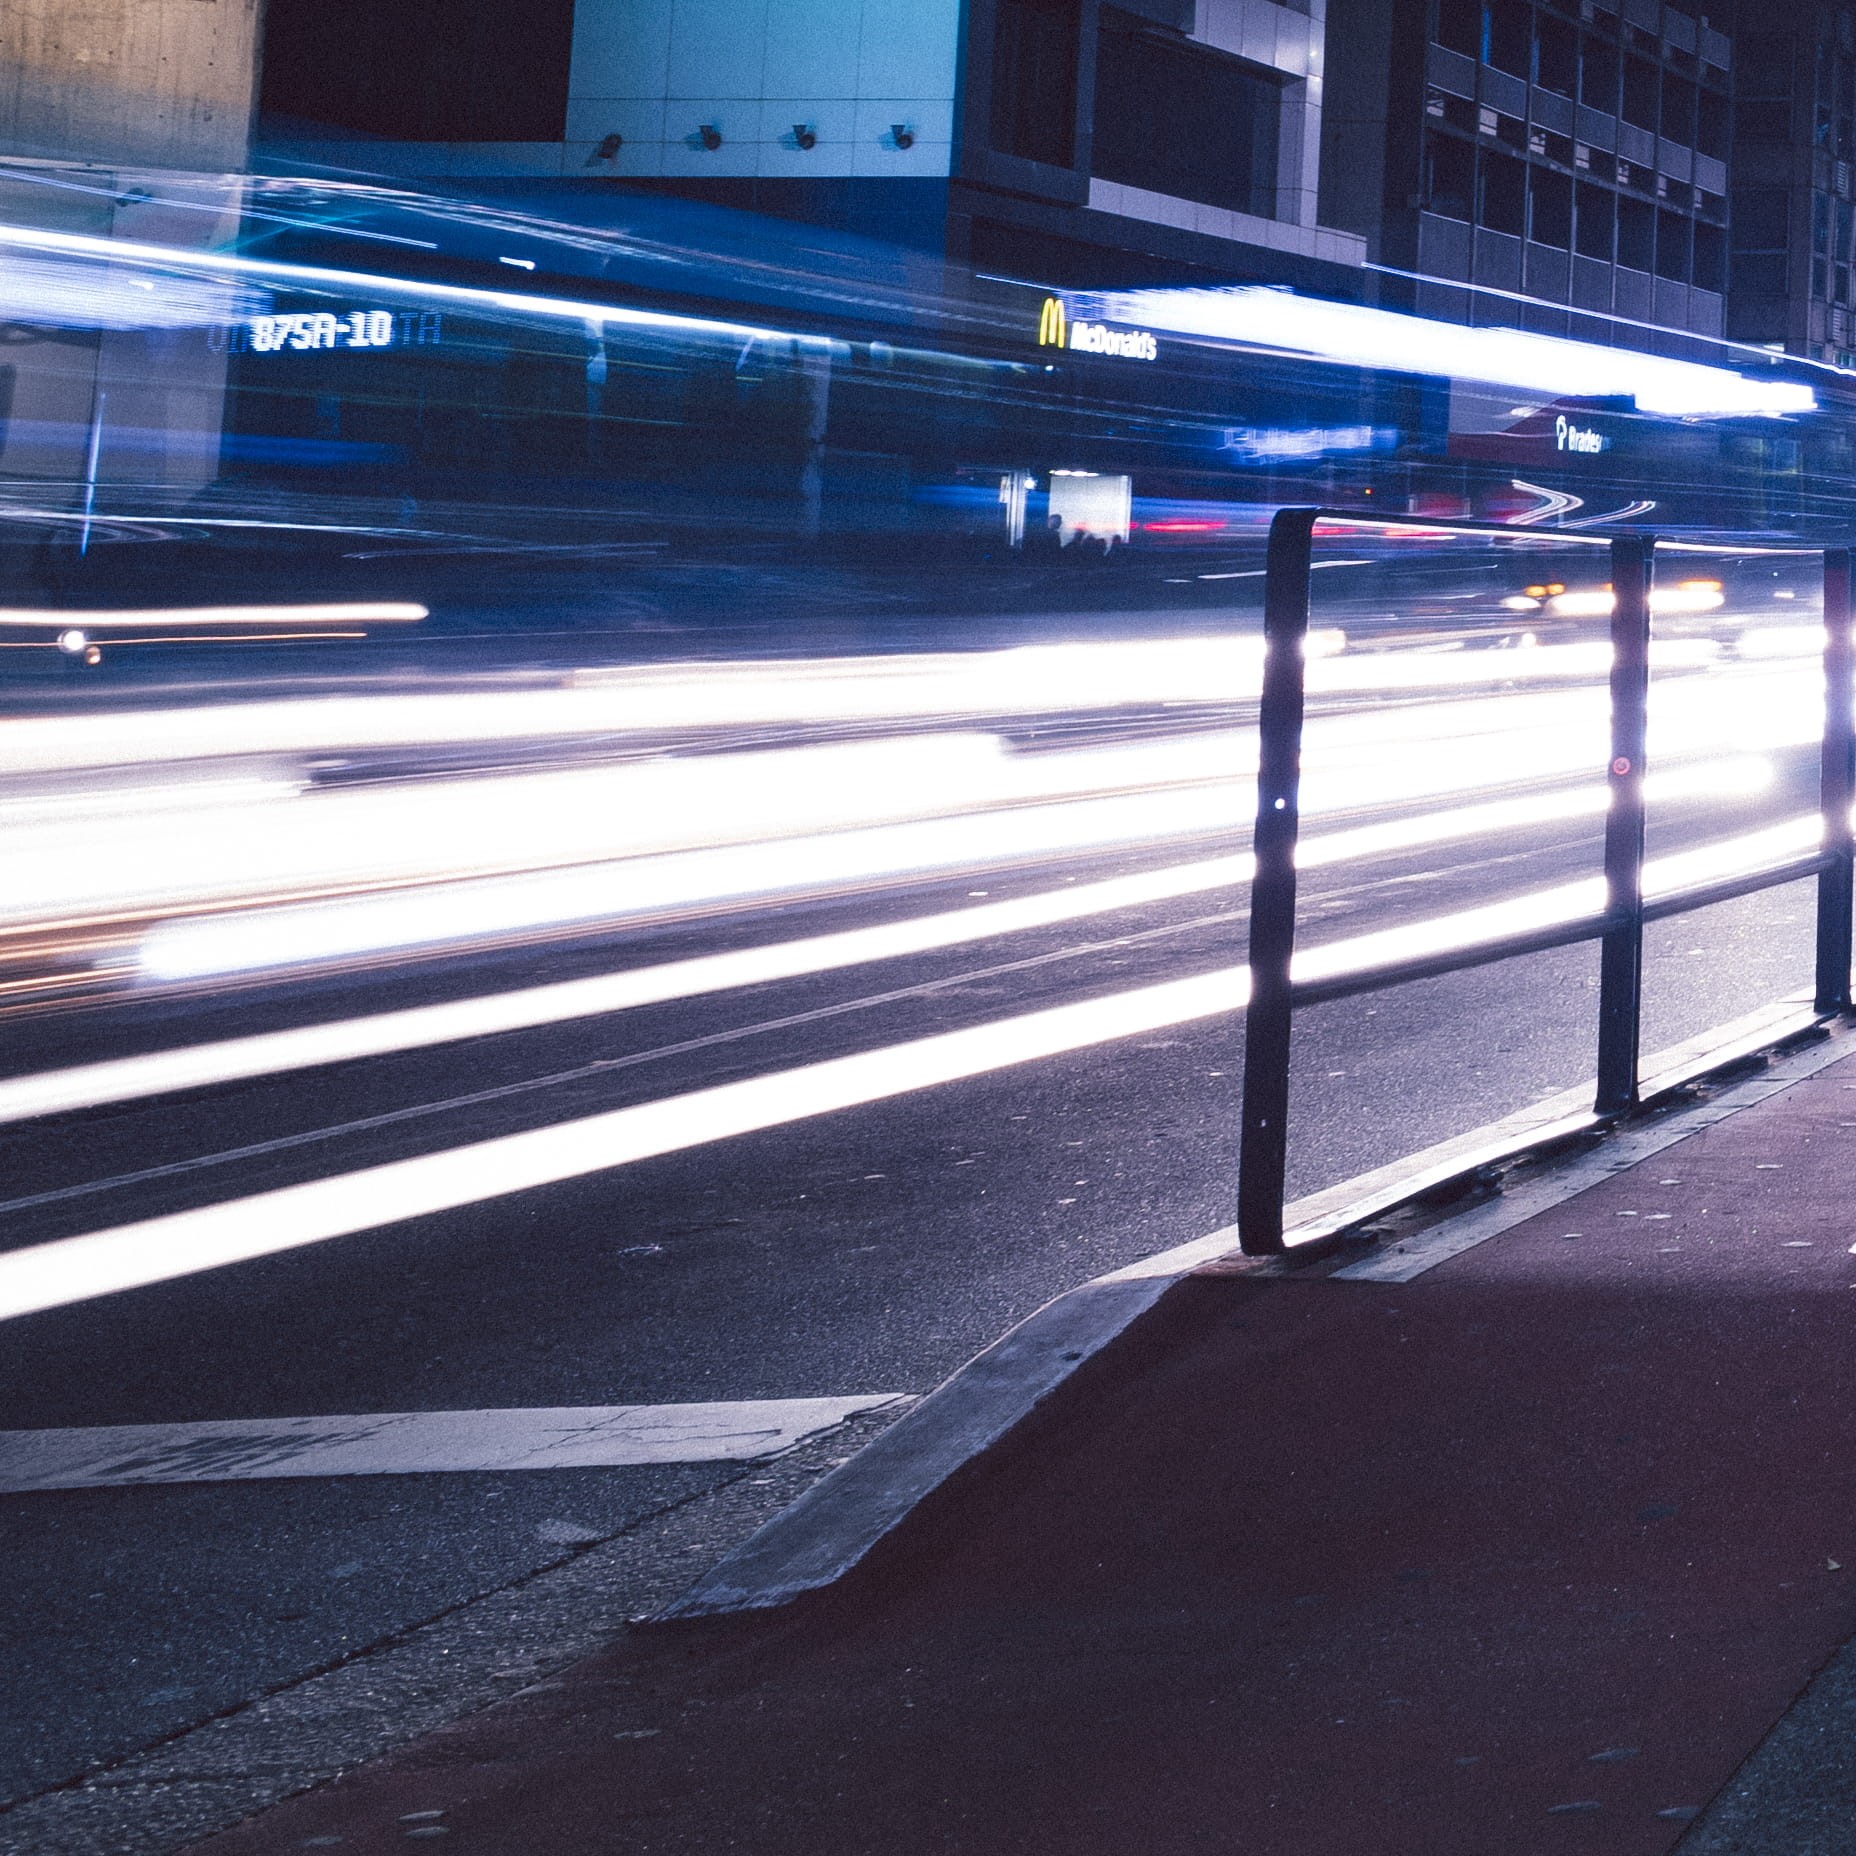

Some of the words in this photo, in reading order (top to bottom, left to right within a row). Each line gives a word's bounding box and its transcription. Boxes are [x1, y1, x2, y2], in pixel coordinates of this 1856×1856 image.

[249, 310, 393, 352] 875A-10
[1070, 321, 1157, 361] McDonald's
[1568, 425, 1611, 453] Brades
